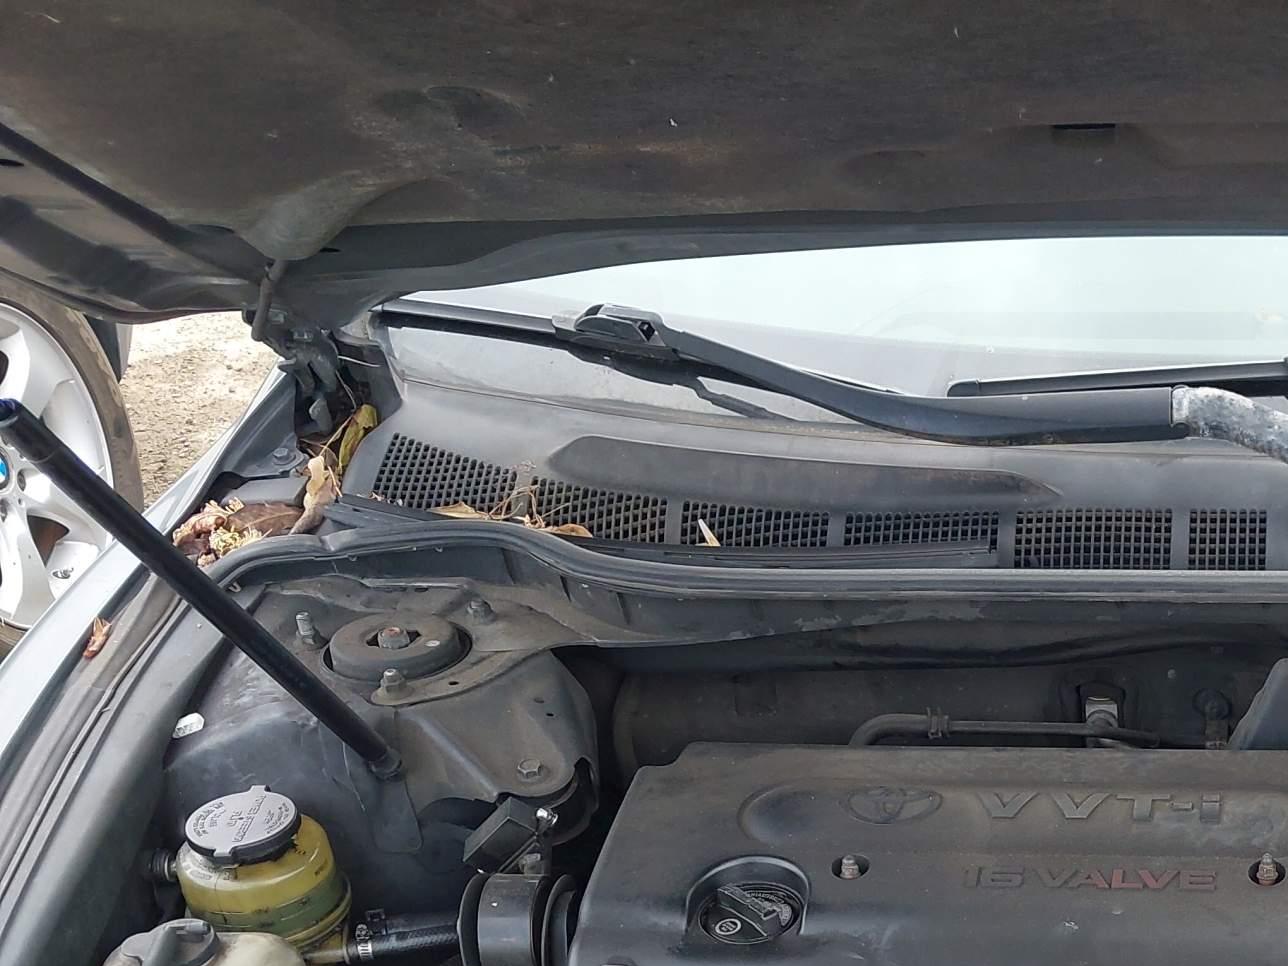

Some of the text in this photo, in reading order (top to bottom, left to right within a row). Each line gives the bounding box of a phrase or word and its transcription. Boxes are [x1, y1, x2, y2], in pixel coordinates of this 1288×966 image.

[976, 791, 1222, 823] VVT-i
[963, 867, 1217, 891] 16 VALVE
